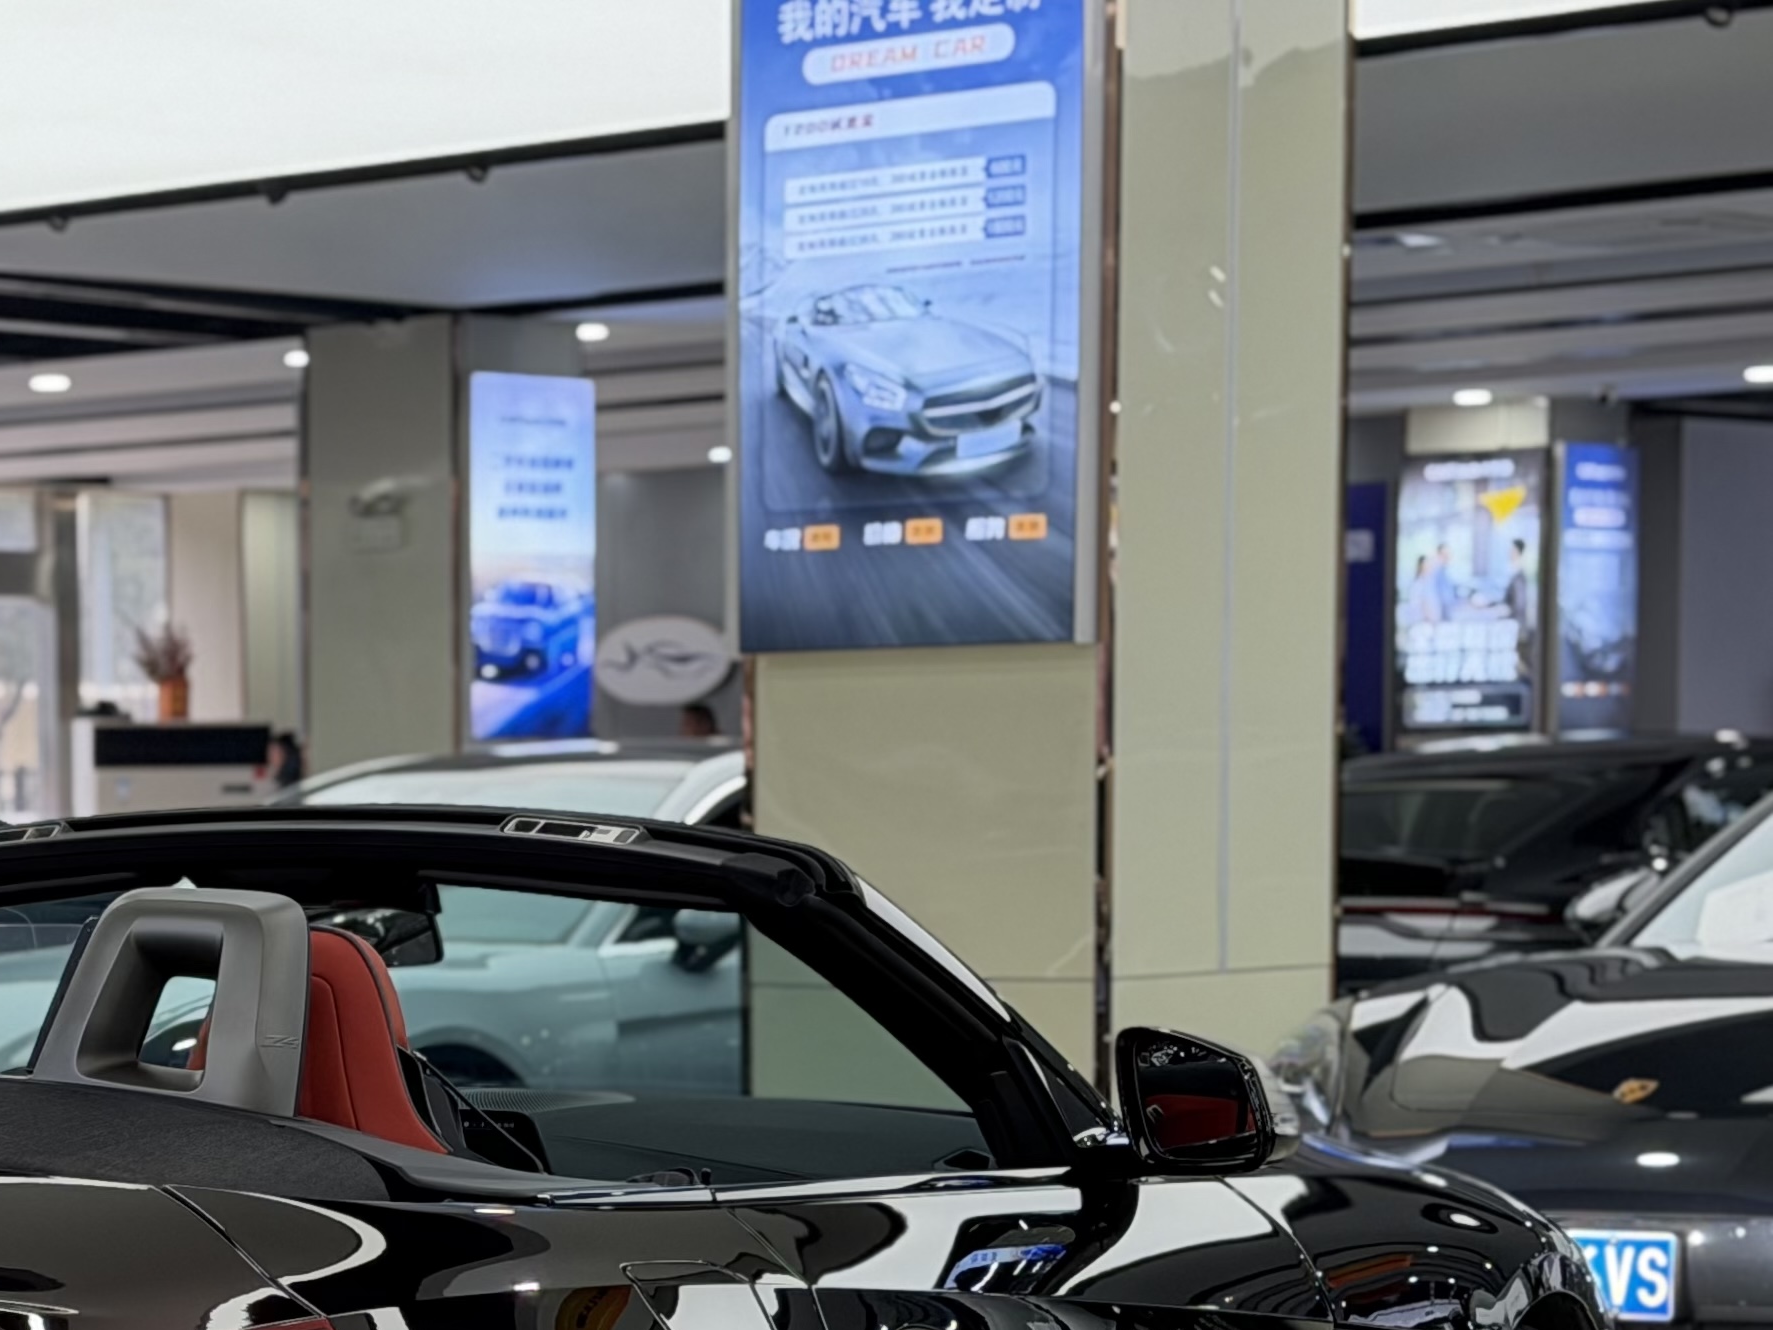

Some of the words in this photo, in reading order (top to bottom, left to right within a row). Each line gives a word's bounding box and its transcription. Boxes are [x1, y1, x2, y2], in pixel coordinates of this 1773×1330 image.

[777, 0, 923, 45] 我的汽车
[830, 44, 918, 73] DREAM
[933, 34, 987, 60] CAR
